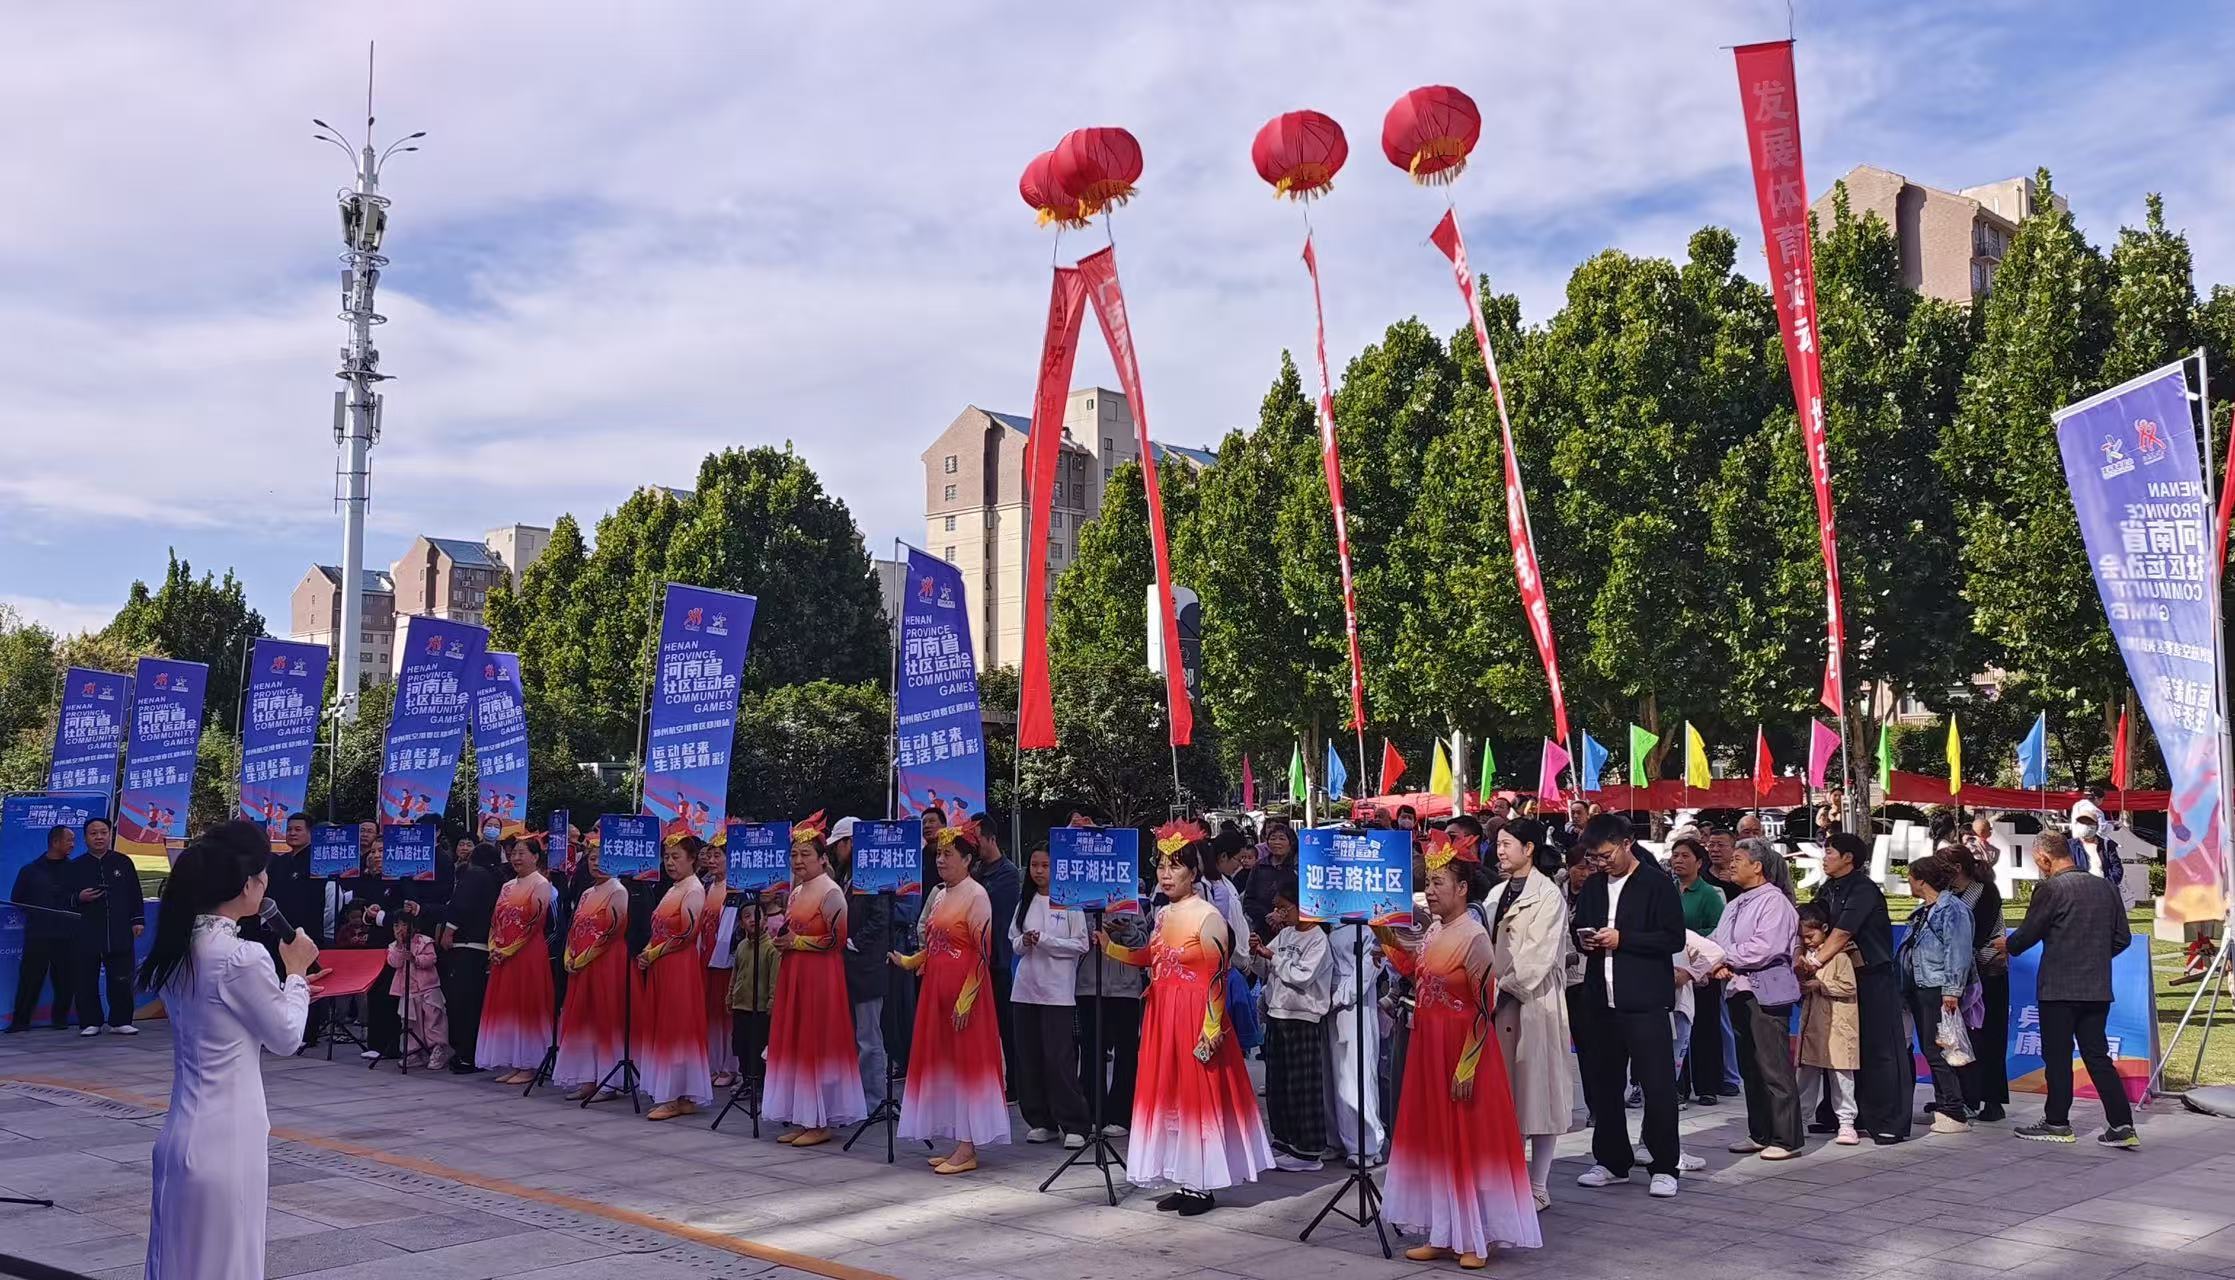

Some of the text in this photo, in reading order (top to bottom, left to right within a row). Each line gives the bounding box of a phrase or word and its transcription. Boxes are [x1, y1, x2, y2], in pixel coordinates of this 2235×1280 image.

[905, 614, 932, 626] HENAN
[906, 625, 951, 639] PROVINCE
[664, 640, 699, 652] HENAN
[905, 633, 959, 660] 河南省
[665, 650, 716, 663] PROVINCE
[905, 652, 972, 676] 社区运动会
[407, 662, 438, 673] HENAN
[663, 658, 723, 681] 河南省
[408, 671, 453, 682] PROVINCE
[663, 674, 737, 695] 社区运动会
[908, 669, 971, 688] COMMUNITY
[254, 681, 283, 691] HENAN
[254, 688, 298, 698] PROVINCE
[406, 678, 459, 698] 河南省
[477, 687, 496, 697] HENAN
[939, 681, 975, 697] GAMES
[138, 696, 166, 705] HENAN
[252, 694, 303, 713] 河南省
[479, 691, 507, 703] PROVINCE
[665, 689, 733, 705] COMMUNITY
[66, 703, 93, 711] HENAN
[139, 702, 180, 711] PROVINCE
[478, 696, 514, 716] 河南省
[694, 700, 733, 714] GAMES
[64, 714, 111, 730] 河南省
[138, 708, 186, 725] 河南省
[253, 705, 315, 724] 社区运动会
[430, 713, 465, 724] GAMES
[138, 719, 197, 735] 社区运动会
[255, 717, 312, 731] COMMUNITY
[277, 726, 312, 736] GAMES
[480, 716, 523, 732] COMMUNITY
[500, 723, 525, 736] GAMES
[65, 735, 118, 745] COMMUNITY
[140, 730, 195, 742] COMMUNITY
[163, 737, 195, 747] GAMES
[899, 726, 963, 751] 运动起来
[88, 742, 118, 750] GAMES
[652, 741, 709, 760] 运动起来
[901, 738, 979, 767] 生活更精彩
[245, 757, 291, 773] 运动起来
[478, 752, 514, 767] 动起来
[479, 758, 525, 777] 活更精彩
[654, 751, 724, 773] 生活更精彩
[130, 766, 176, 780] 运动起来
[603, 838, 655, 857] 长安路社区
[730, 849, 786, 869] 护航路社区
[857, 848, 916, 869] 康平湖社区
[1056, 859, 1131, 883] 恩平湖社区
[1306, 864, 1404, 893] 迎宾路社区
